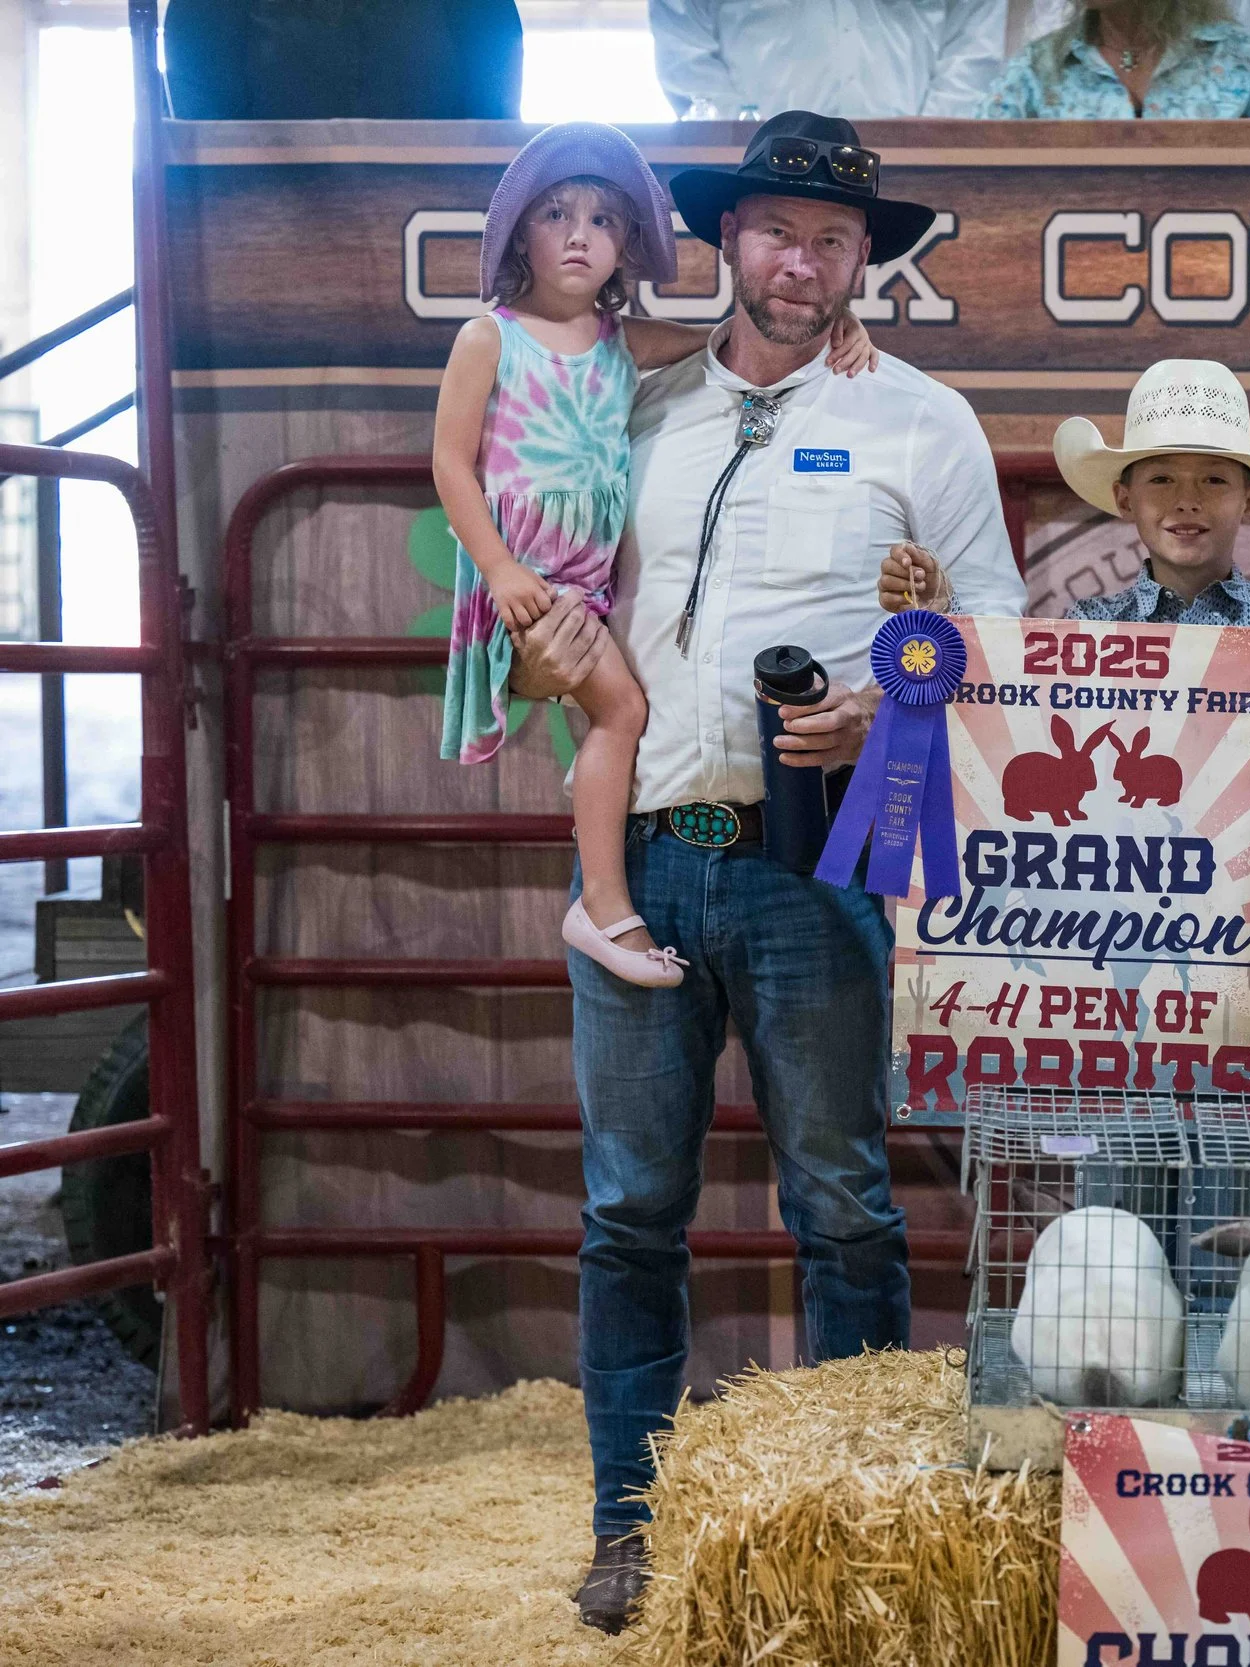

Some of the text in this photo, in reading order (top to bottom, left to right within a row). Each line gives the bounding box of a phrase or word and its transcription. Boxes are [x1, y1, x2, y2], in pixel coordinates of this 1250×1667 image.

[403, 210, 960, 325] COK
[1023, 631, 1171, 679] 2025
[1049, 682, 1180, 714] COUNTY
[887, 760, 923, 774] CHAMPION
[884, 803, 913, 816] COUNTY
[888, 791, 913, 803] CROOK
[888, 815, 905, 827] FAIR
[962, 829, 1216, 894] GRAND
[929, 980, 1219, 1035] 4-H PEN OF
[1116, 1469, 1236, 1500] CROOK
